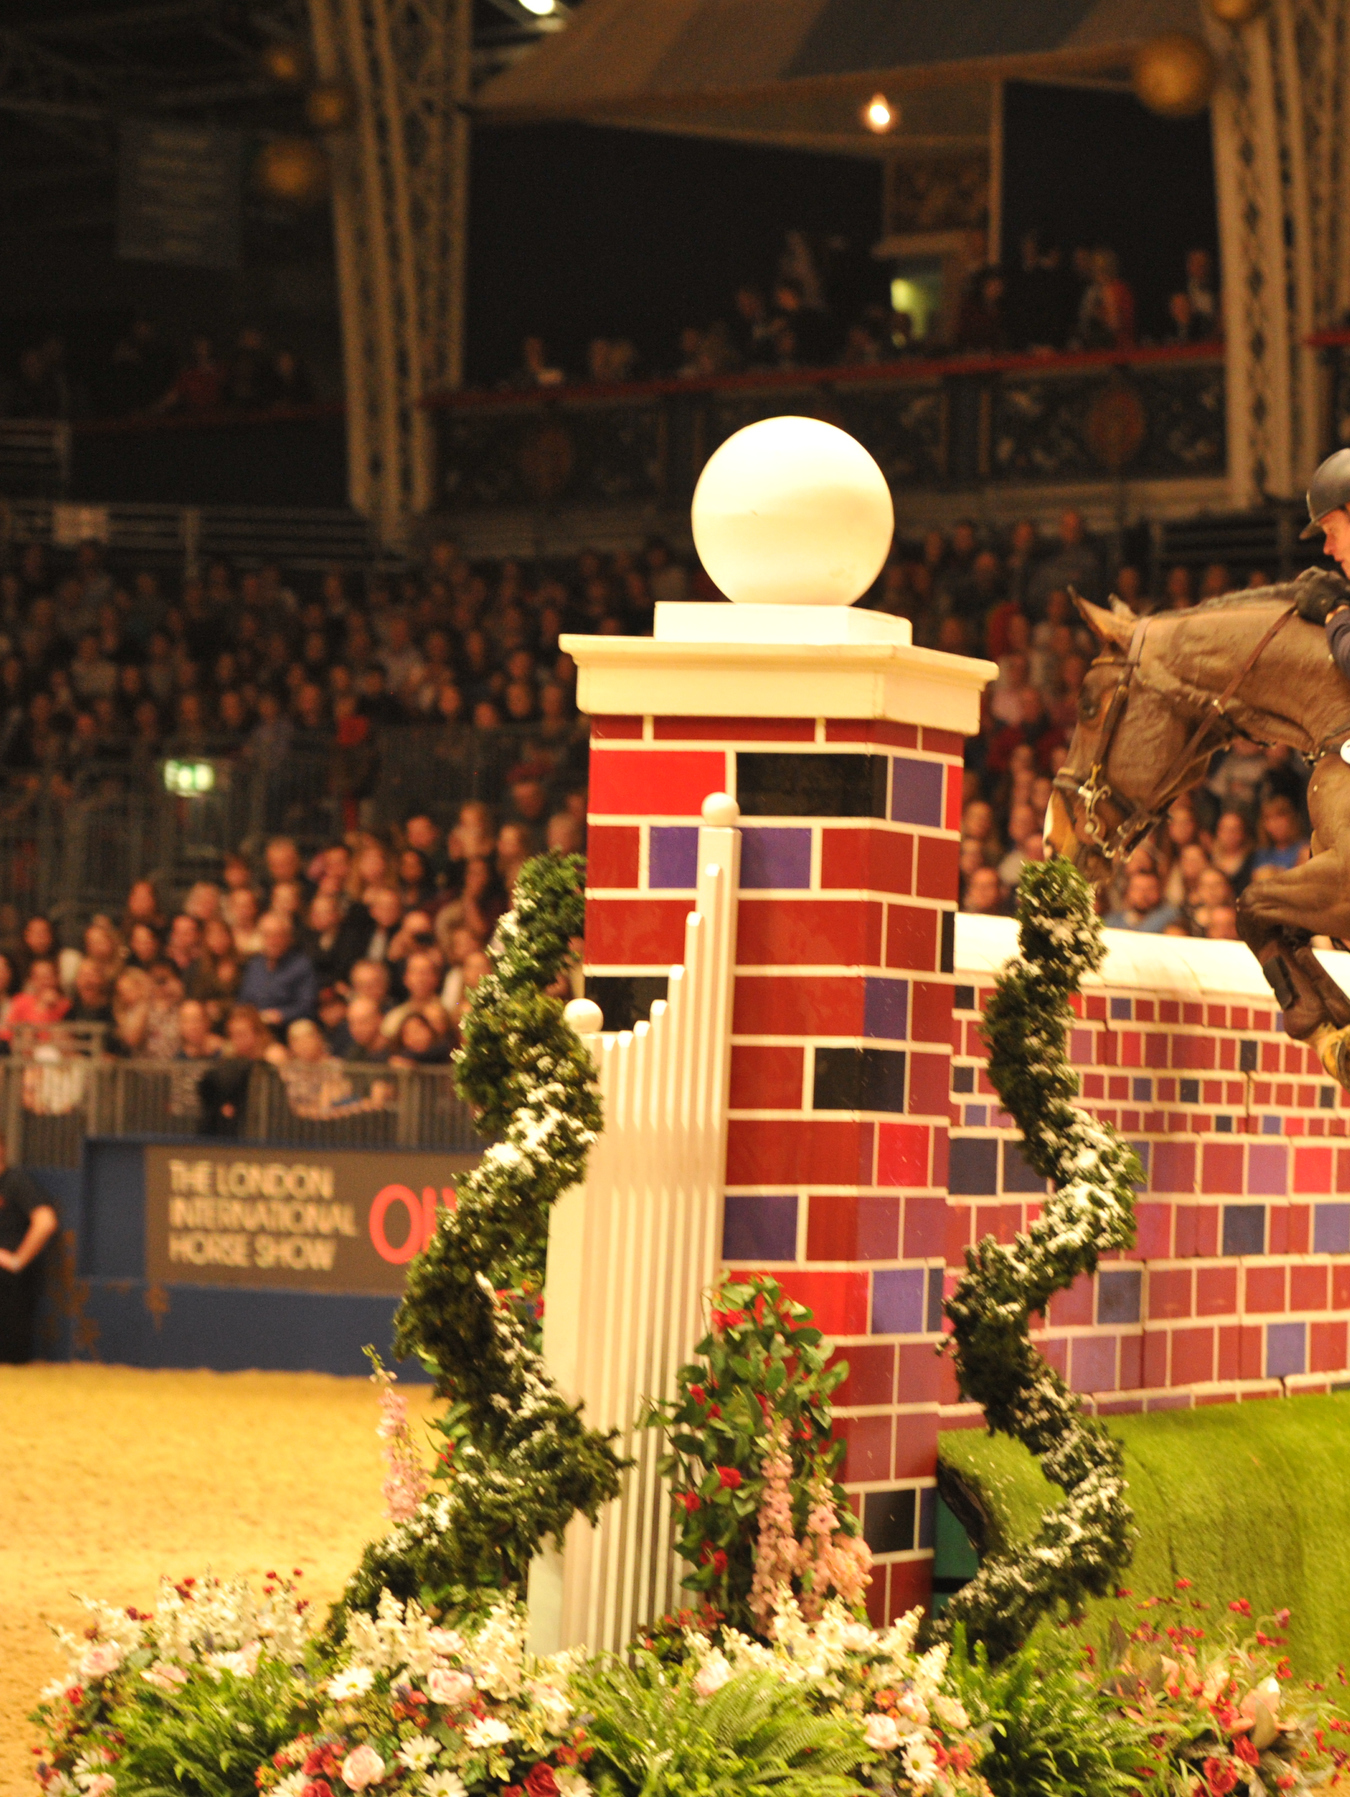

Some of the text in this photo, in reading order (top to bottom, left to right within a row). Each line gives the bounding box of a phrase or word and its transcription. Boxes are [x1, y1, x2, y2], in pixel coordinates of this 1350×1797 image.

[169, 1159, 335, 1200] THE LONDON
[168, 1196, 357, 1238] INTERNATIONAL
[168, 1230, 337, 1271] HORSE SHOW
